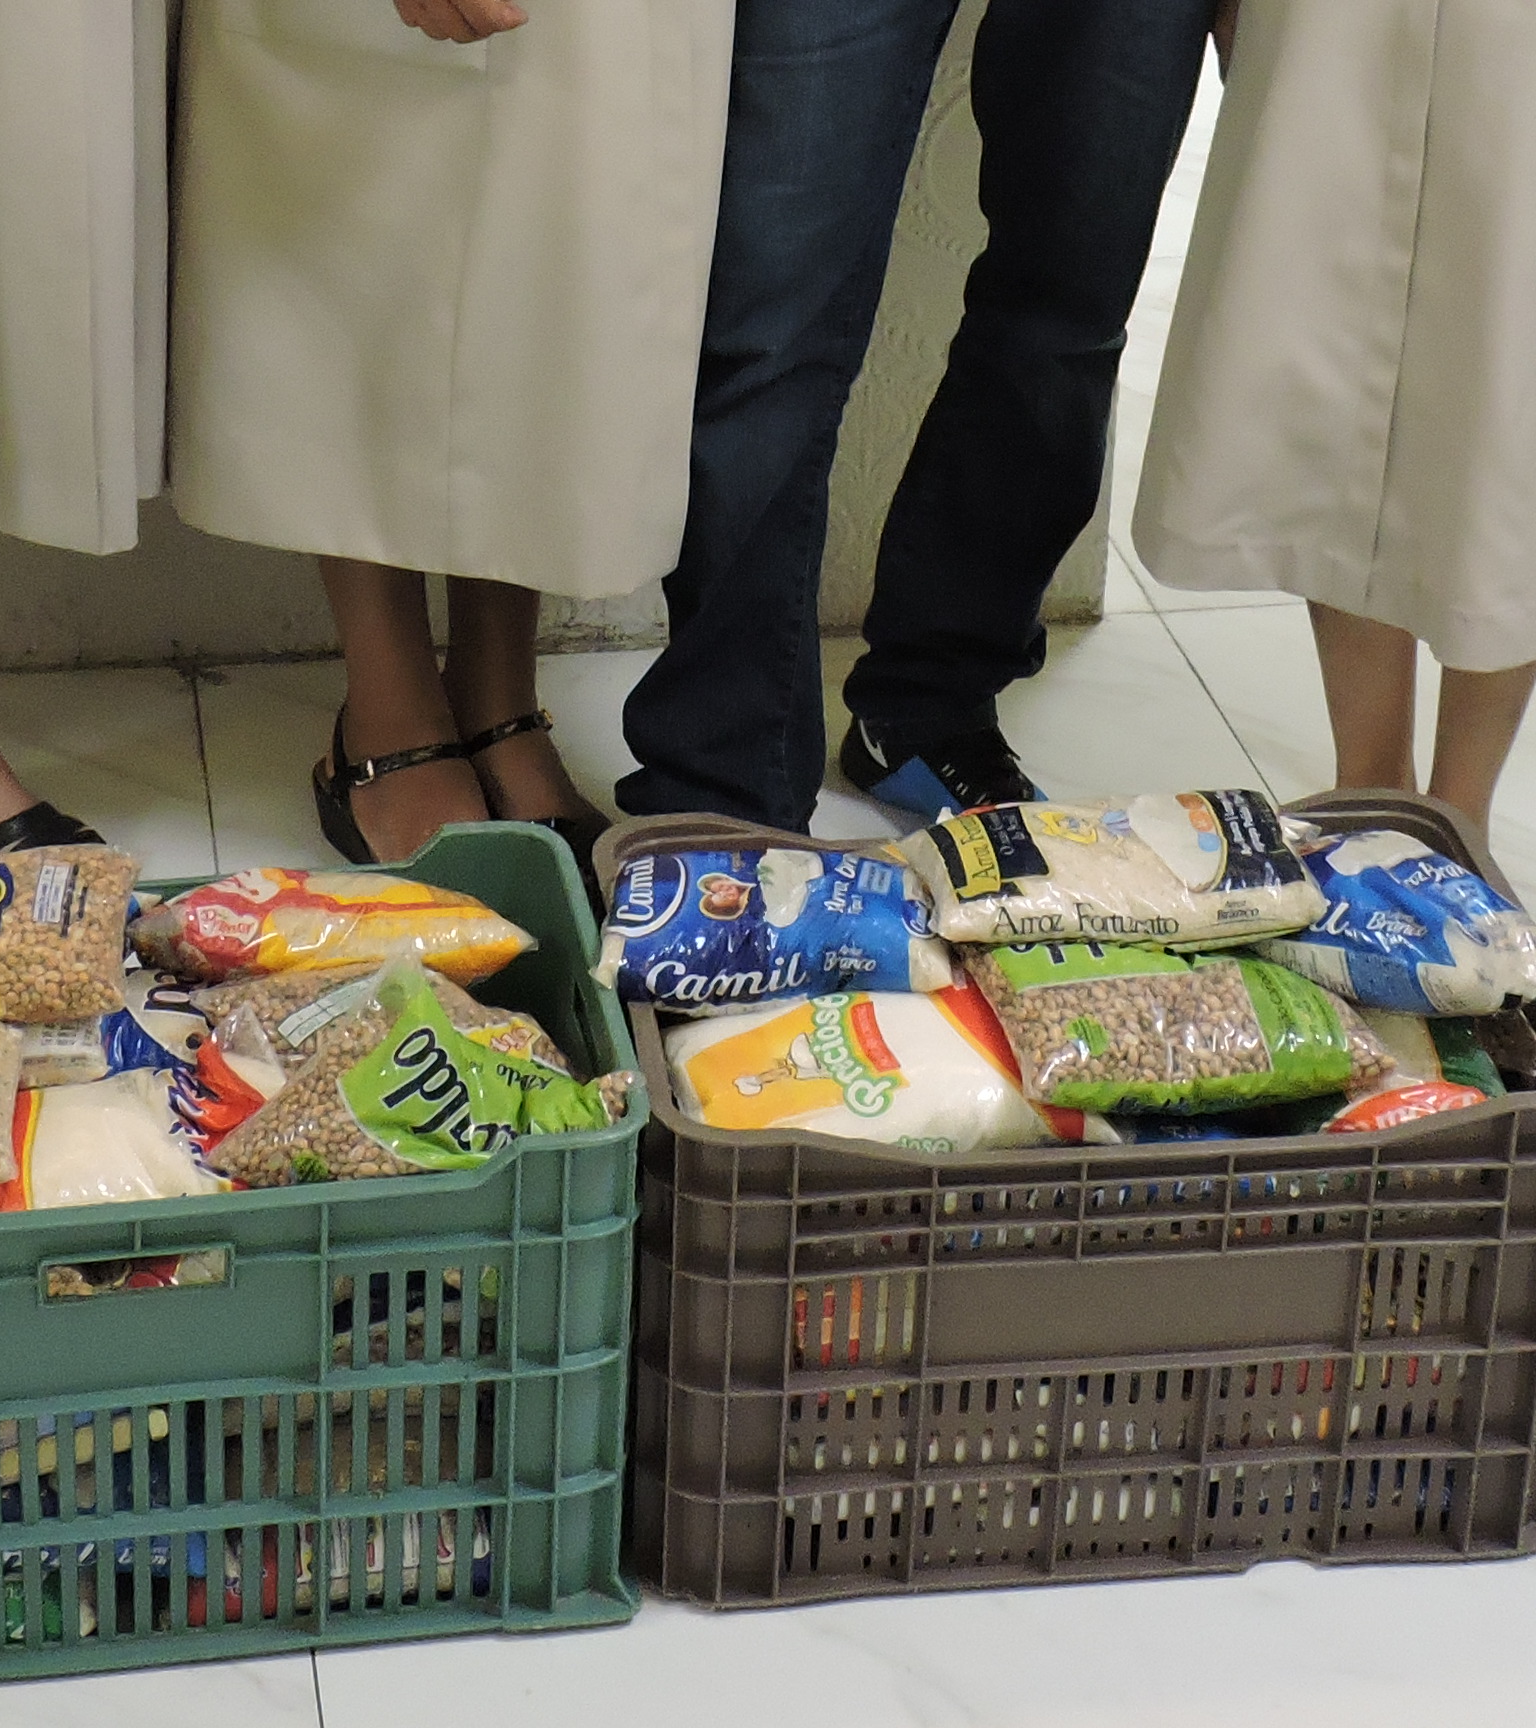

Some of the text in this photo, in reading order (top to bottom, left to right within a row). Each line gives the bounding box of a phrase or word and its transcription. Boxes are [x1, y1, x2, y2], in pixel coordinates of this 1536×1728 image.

[992, 902, 1181, 936] Arroz Fortunato
[645, 952, 809, 1003] Camil
